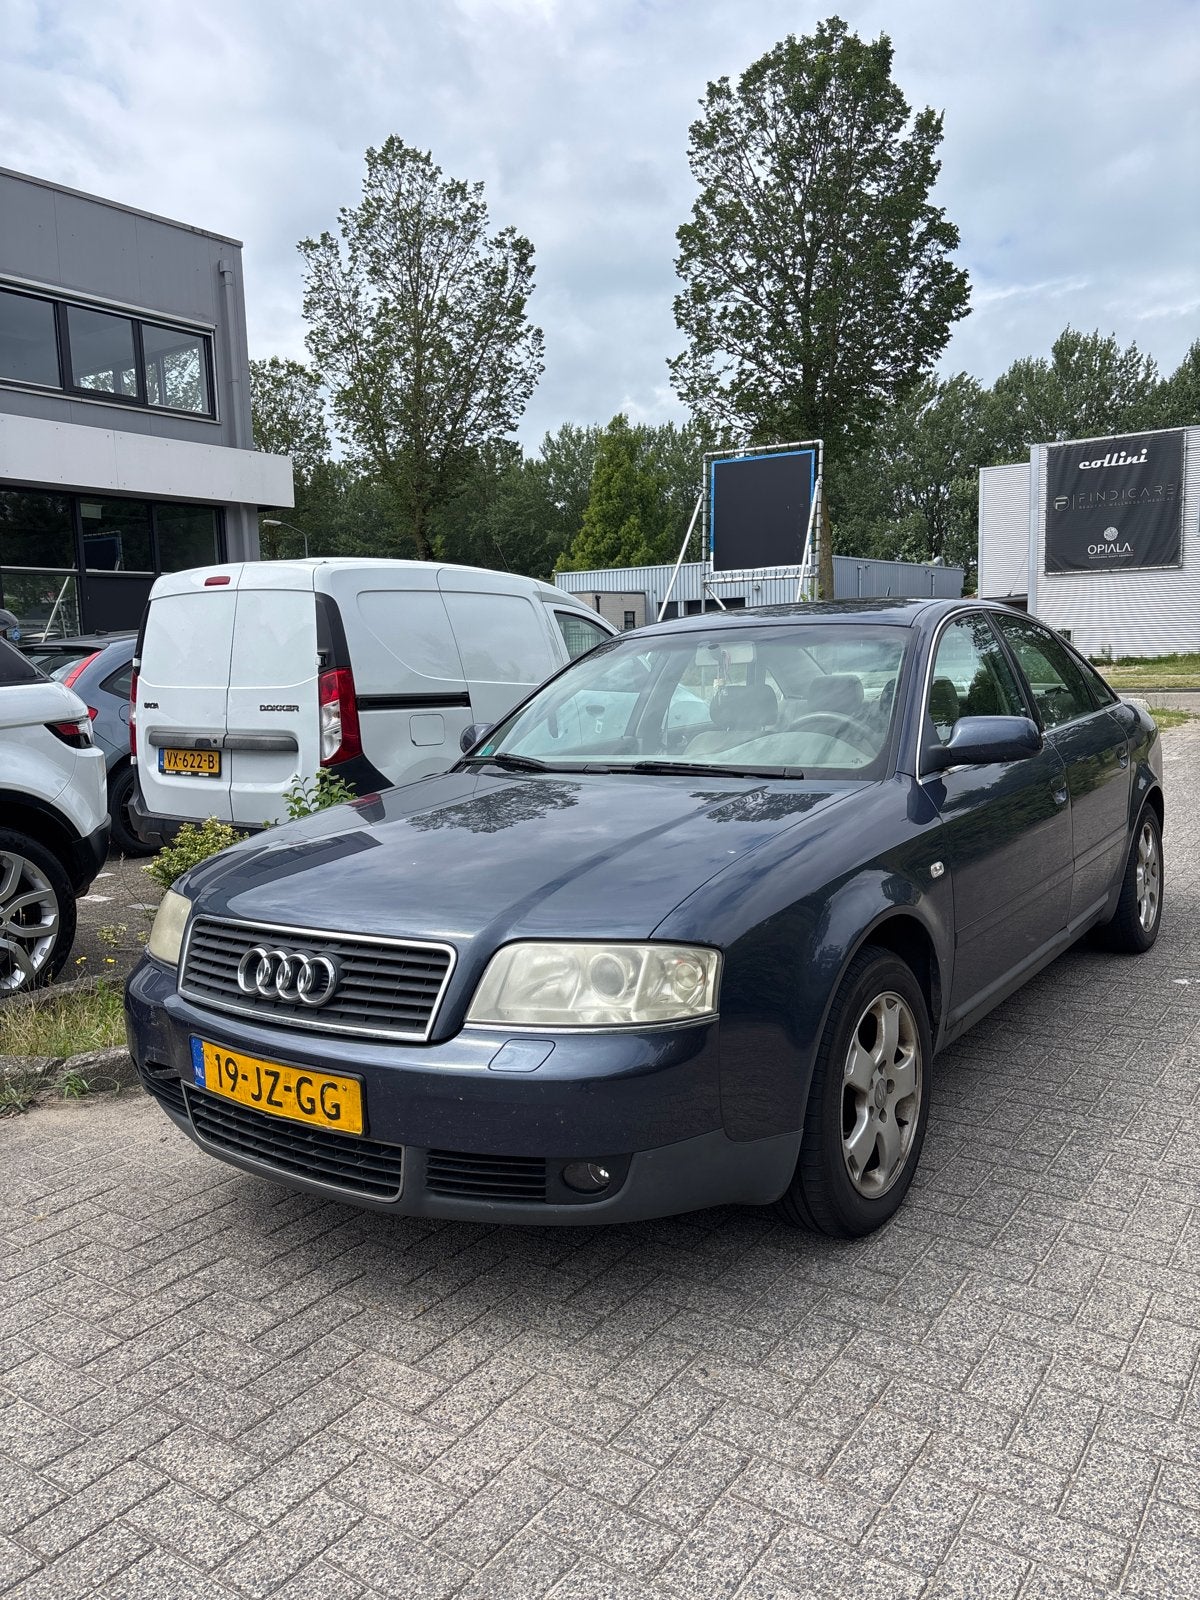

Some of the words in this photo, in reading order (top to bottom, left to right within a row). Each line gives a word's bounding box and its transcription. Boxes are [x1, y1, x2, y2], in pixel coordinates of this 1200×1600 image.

[1079, 448, 1148, 470] collini
[1078, 483, 1175, 503] FINDICARE
[259, 704, 300, 712] DOKKER
[166, 751, 215, 769] VX-622-B
[195, 1066, 205, 1079] NL
[214, 1053, 341, 1121] 19-JZ-GG
